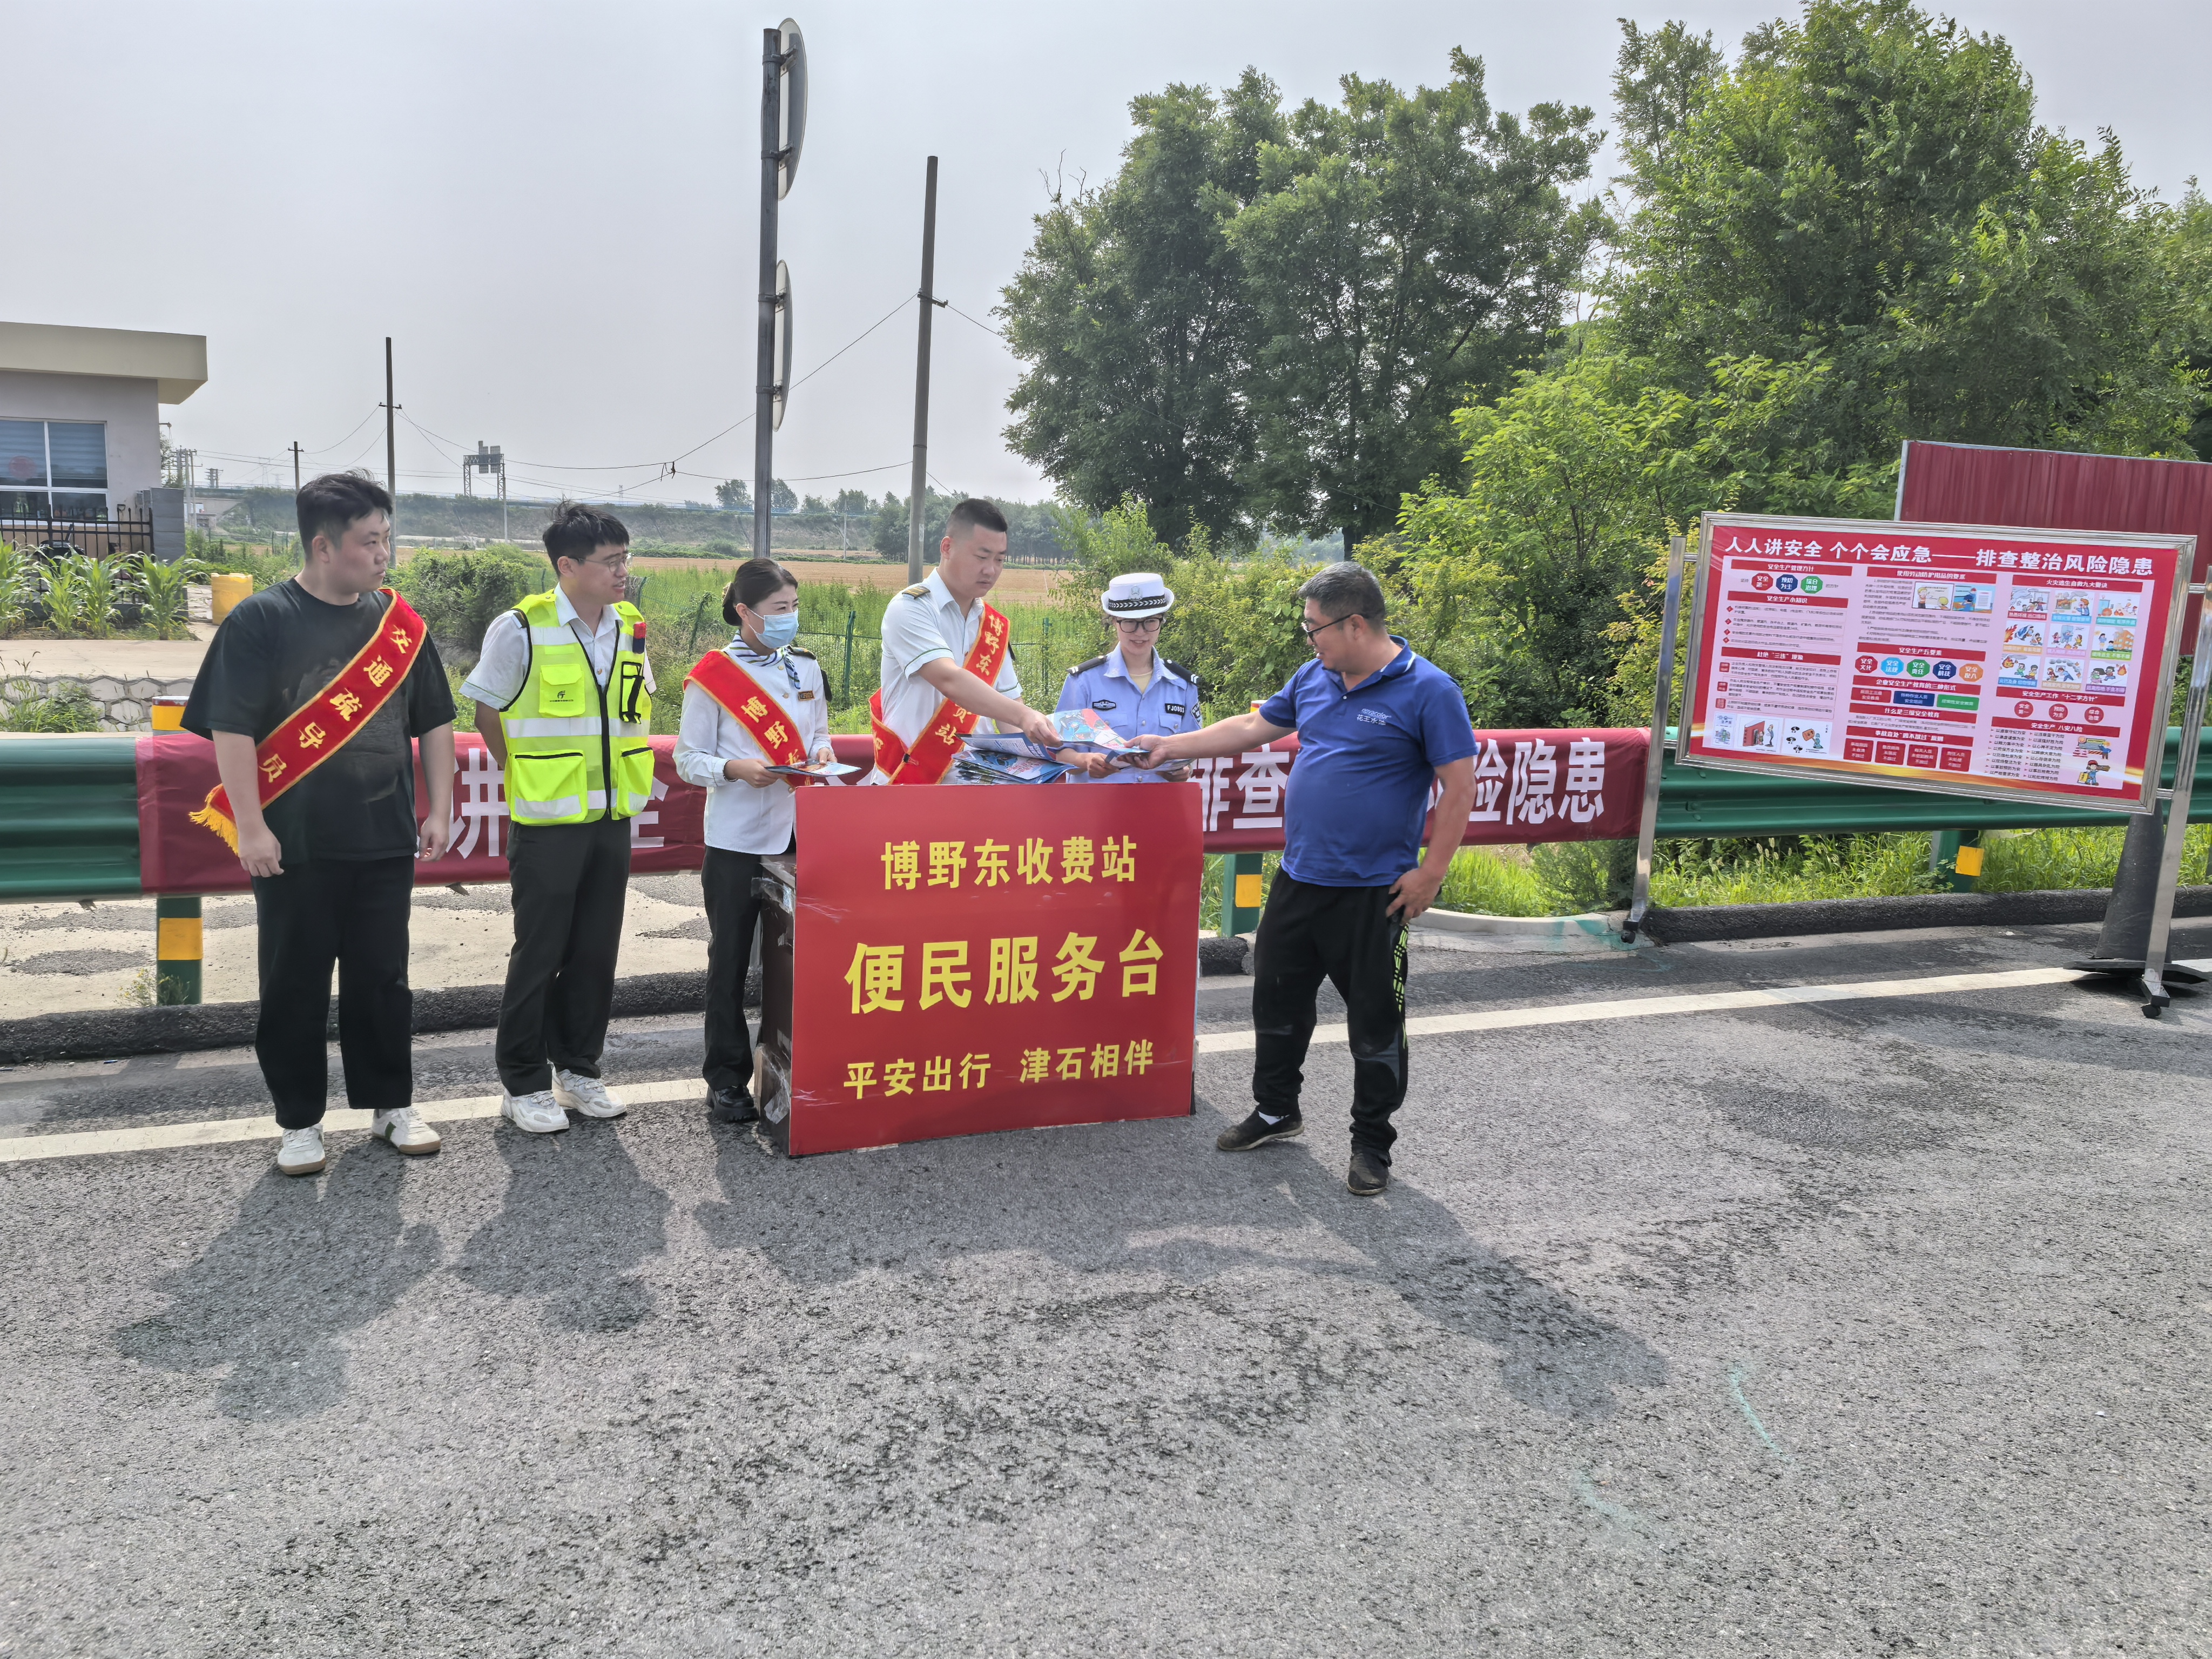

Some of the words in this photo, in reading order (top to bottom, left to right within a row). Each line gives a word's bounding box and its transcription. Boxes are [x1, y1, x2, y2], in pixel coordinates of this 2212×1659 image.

[1725, 536, 1823, 557] 人人讲安全
[1767, 563, 1814, 572] 安全生产管理方针
[1766, 595, 1808, 604] 安全生产小知识
[1898, 646, 1942, 656] 安全生产五要素
[935, 614, 1003, 745] 博野东站
[259, 624, 412, 783] 交通疏导员
[1884, 707, 1940, 718] 什么是三级安全教育
[2030, 722, 2056, 730] 安全生产
[881, 835, 1137, 890] 博野东收费站
[844, 929, 1163, 1014] 便民服务台
[844, 1052, 991, 1100] 平安出行
[1020, 1038, 1154, 1083] 津石相伴
